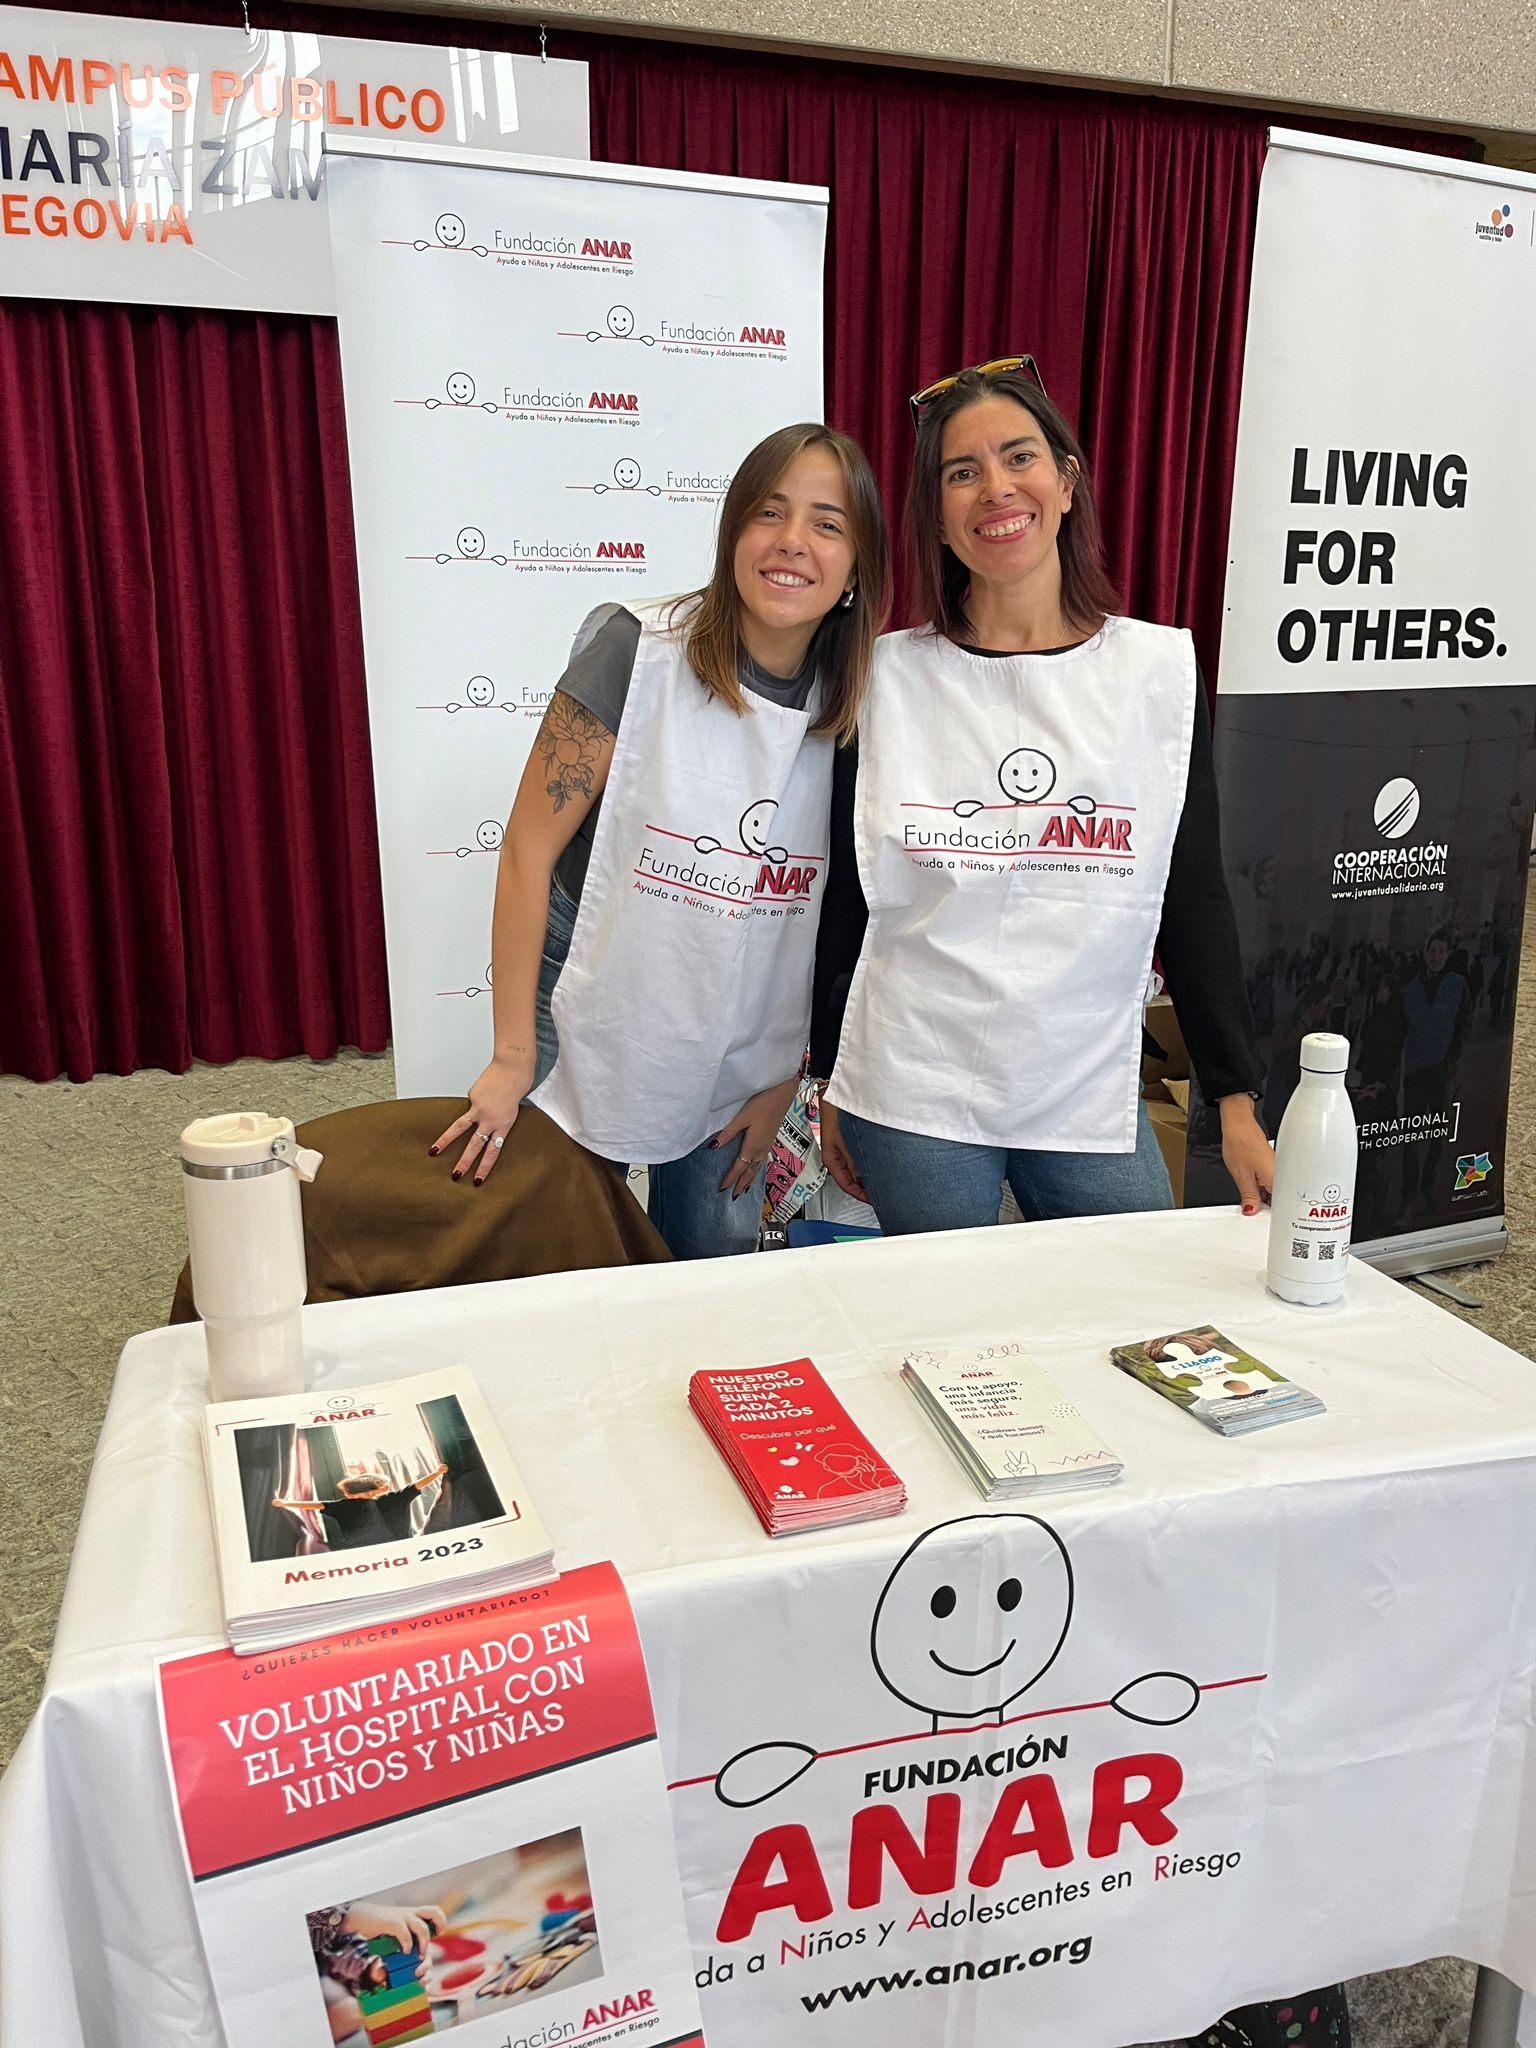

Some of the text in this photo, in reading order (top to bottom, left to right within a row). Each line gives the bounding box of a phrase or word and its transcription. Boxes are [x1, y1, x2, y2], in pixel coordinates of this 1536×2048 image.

[212, 62, 445, 132] PÚBLICO
[1, 193, 194, 245] EGOVIA
[1475, 222, 1504, 236] juventud
[495, 230, 633, 260] Fundación ANAR
[496, 256, 520, 266] Ayuda
[556, 261, 600, 273] Adolescentes
[612, 266, 634, 277] Riesgo
[661, 320, 786, 346] Fundación ANAR
[662, 345, 684, 354] Ayuda
[716, 350, 758, 359] Adolescentes
[504, 387, 639, 411] Fundación ANAR
[505, 412, 528, 422] Ayuda
[564, 415, 607, 425] Adolescentes
[618, 418, 640, 428] Riesgo
[1290, 447, 1468, 509] LIVING
[668, 495, 689, 503] Ayuda
[513, 540, 645, 559] Fundación ANAR
[1283, 529, 1396, 586] FOR
[515, 564, 537, 573] Ayuda
[572, 565, 614, 573] Adolescentes
[625, 566, 647, 574] Riesgo
[1277, 607, 1507, 664] OTHERS.
[904, 815, 1132, 851] Fundación ANAR
[1333, 841, 1448, 869] COOPERACIÓN
[639, 847, 753, 898] Fundación
[947, 861, 955, 869] a
[960, 859, 995, 872] Niños
[998, 864, 1006, 874] y
[1009, 861, 1081, 873] Adolescentes
[1085, 864, 1100, 874] en
[1102, 863, 1134, 878] Riesgo
[1332, 861, 1447, 885] INTERNACIONAL
[633, 880, 669, 900] Ayuda
[671, 894, 679, 902] a
[683, 895, 715, 913] Niños
[770, 908, 783, 917] en
[1331, 881, 1444, 900] www.juventudsolidaria.org
[1375, 1127, 1448, 1148] COOPERATION
[1308, 1206, 1347, 1218] ANAR
[708, 1370, 789, 1385] NUESTRO
[712, 1377, 805, 1394] TELÉFONO
[961, 1371, 994, 1379] ANAR
[719, 1391, 782, 1403] SUENA
[939, 1385, 964, 1393] Con
[969, 1388, 1016, 1398] infancia
[313, 1408, 376, 1423] ANAR
[724, 1399, 793, 1412] CADA 2
[730, 1406, 814, 1422] MINUTOS
[981, 1402, 1007, 1411] vida
[739, 1423, 836, 1441] Descubre por qué
[284, 1537, 484, 1585] Memoria 2023
[242, 1590, 550, 1680] ¿QUIERES HACER VOLUNTARIADO?
[219, 1615, 592, 1749] VOLUNTARIADO EN
[243, 1655, 586, 1786] EL HOSPITAL CON
[281, 1701, 566, 1815] NIÑOS Y NIÑAS
[863, 1734, 1069, 1798] FUNDACIÓN
[715, 1752, 1184, 1944] ANAR
[694, 1848, 1243, 1988] da a Niños y Adolescentes en Riesgo
[800, 1933, 1093, 2014] www.anar.org
[582, 1988, 655, 2031] ANAR
[614, 2028, 625, 2037] en
[628, 2017, 660, 2033] Riesgo
